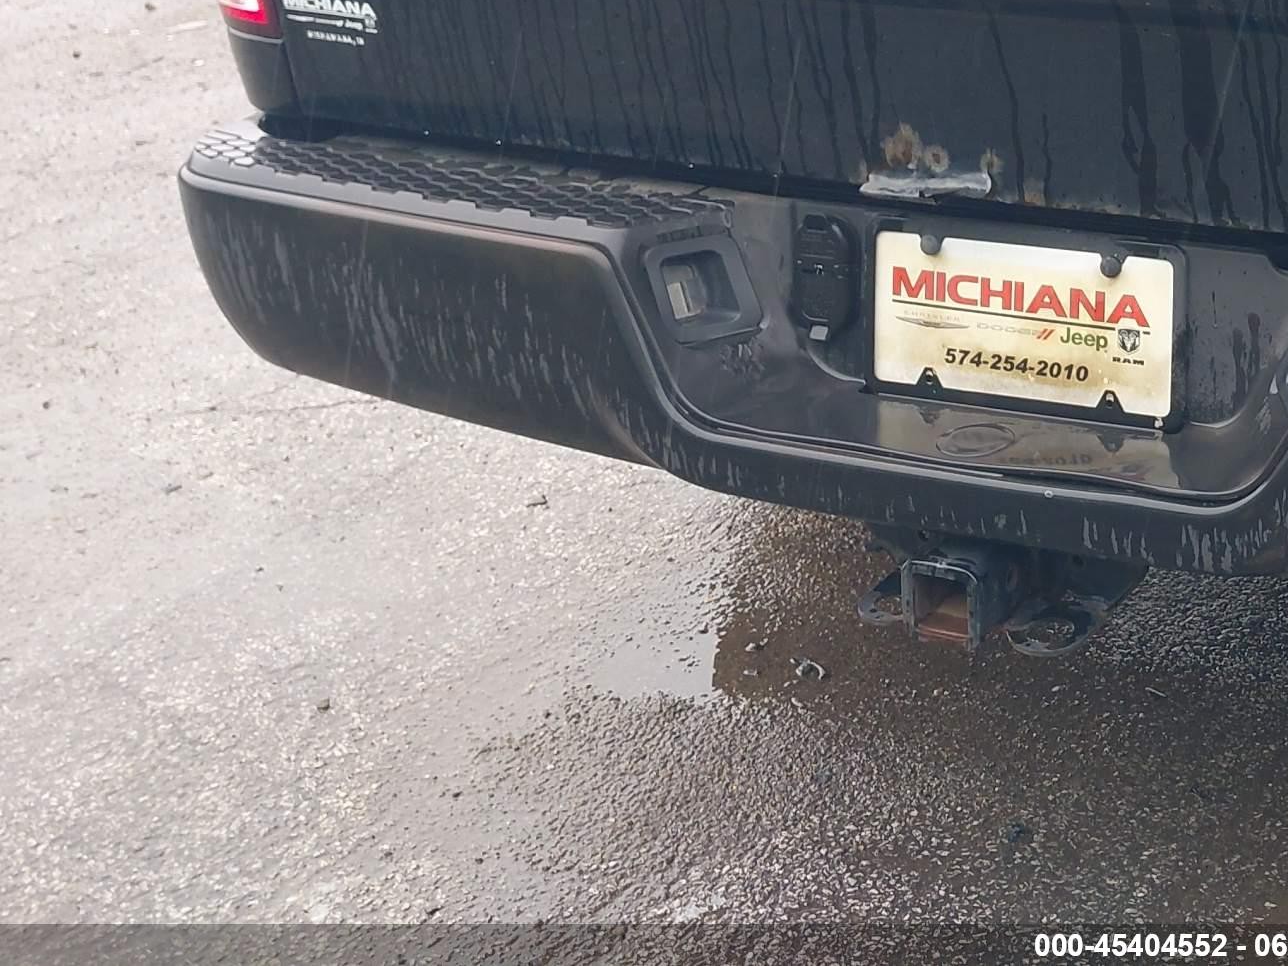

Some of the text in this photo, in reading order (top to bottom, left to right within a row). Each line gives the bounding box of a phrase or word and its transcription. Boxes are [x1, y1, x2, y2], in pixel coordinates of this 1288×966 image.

[892, 265, 1150, 328] MICHIANA
[1060, 327, 1108, 352] Jeep
[944, 347, 1089, 383] 574-254-2010
[1112, 356, 1145, 366] RAM
